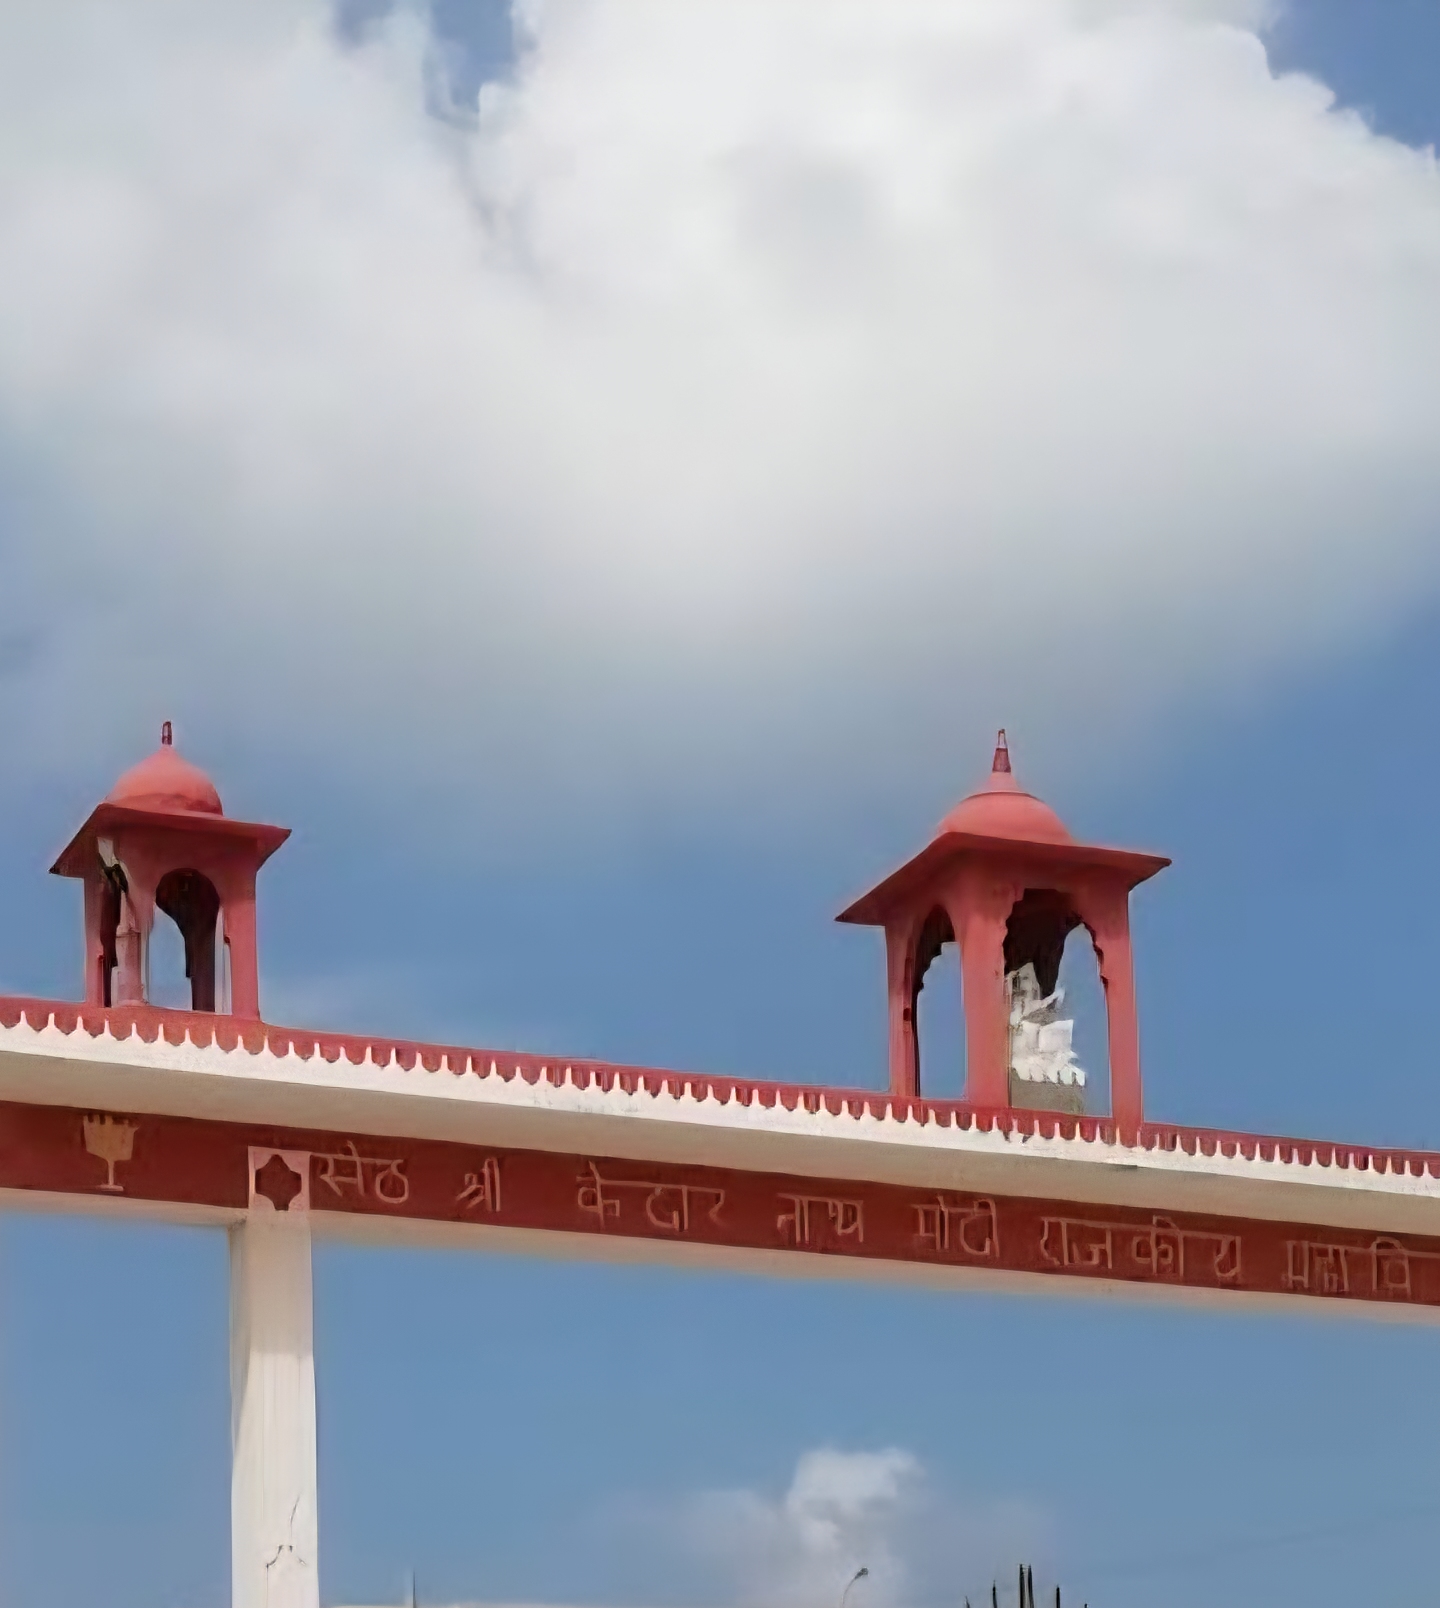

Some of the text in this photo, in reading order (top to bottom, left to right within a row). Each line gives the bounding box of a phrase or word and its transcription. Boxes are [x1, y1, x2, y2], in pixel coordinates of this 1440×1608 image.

[310, 1140, 409, 1203] सेठ
[455, 1155, 501, 1213] श्री
[575, 1160, 733, 1232] केदार
[776, 1191, 864, 1245] नाथ
[912, 1193, 1000, 1258] मोदी
[1041, 1213, 1243, 1284] राजकीय
